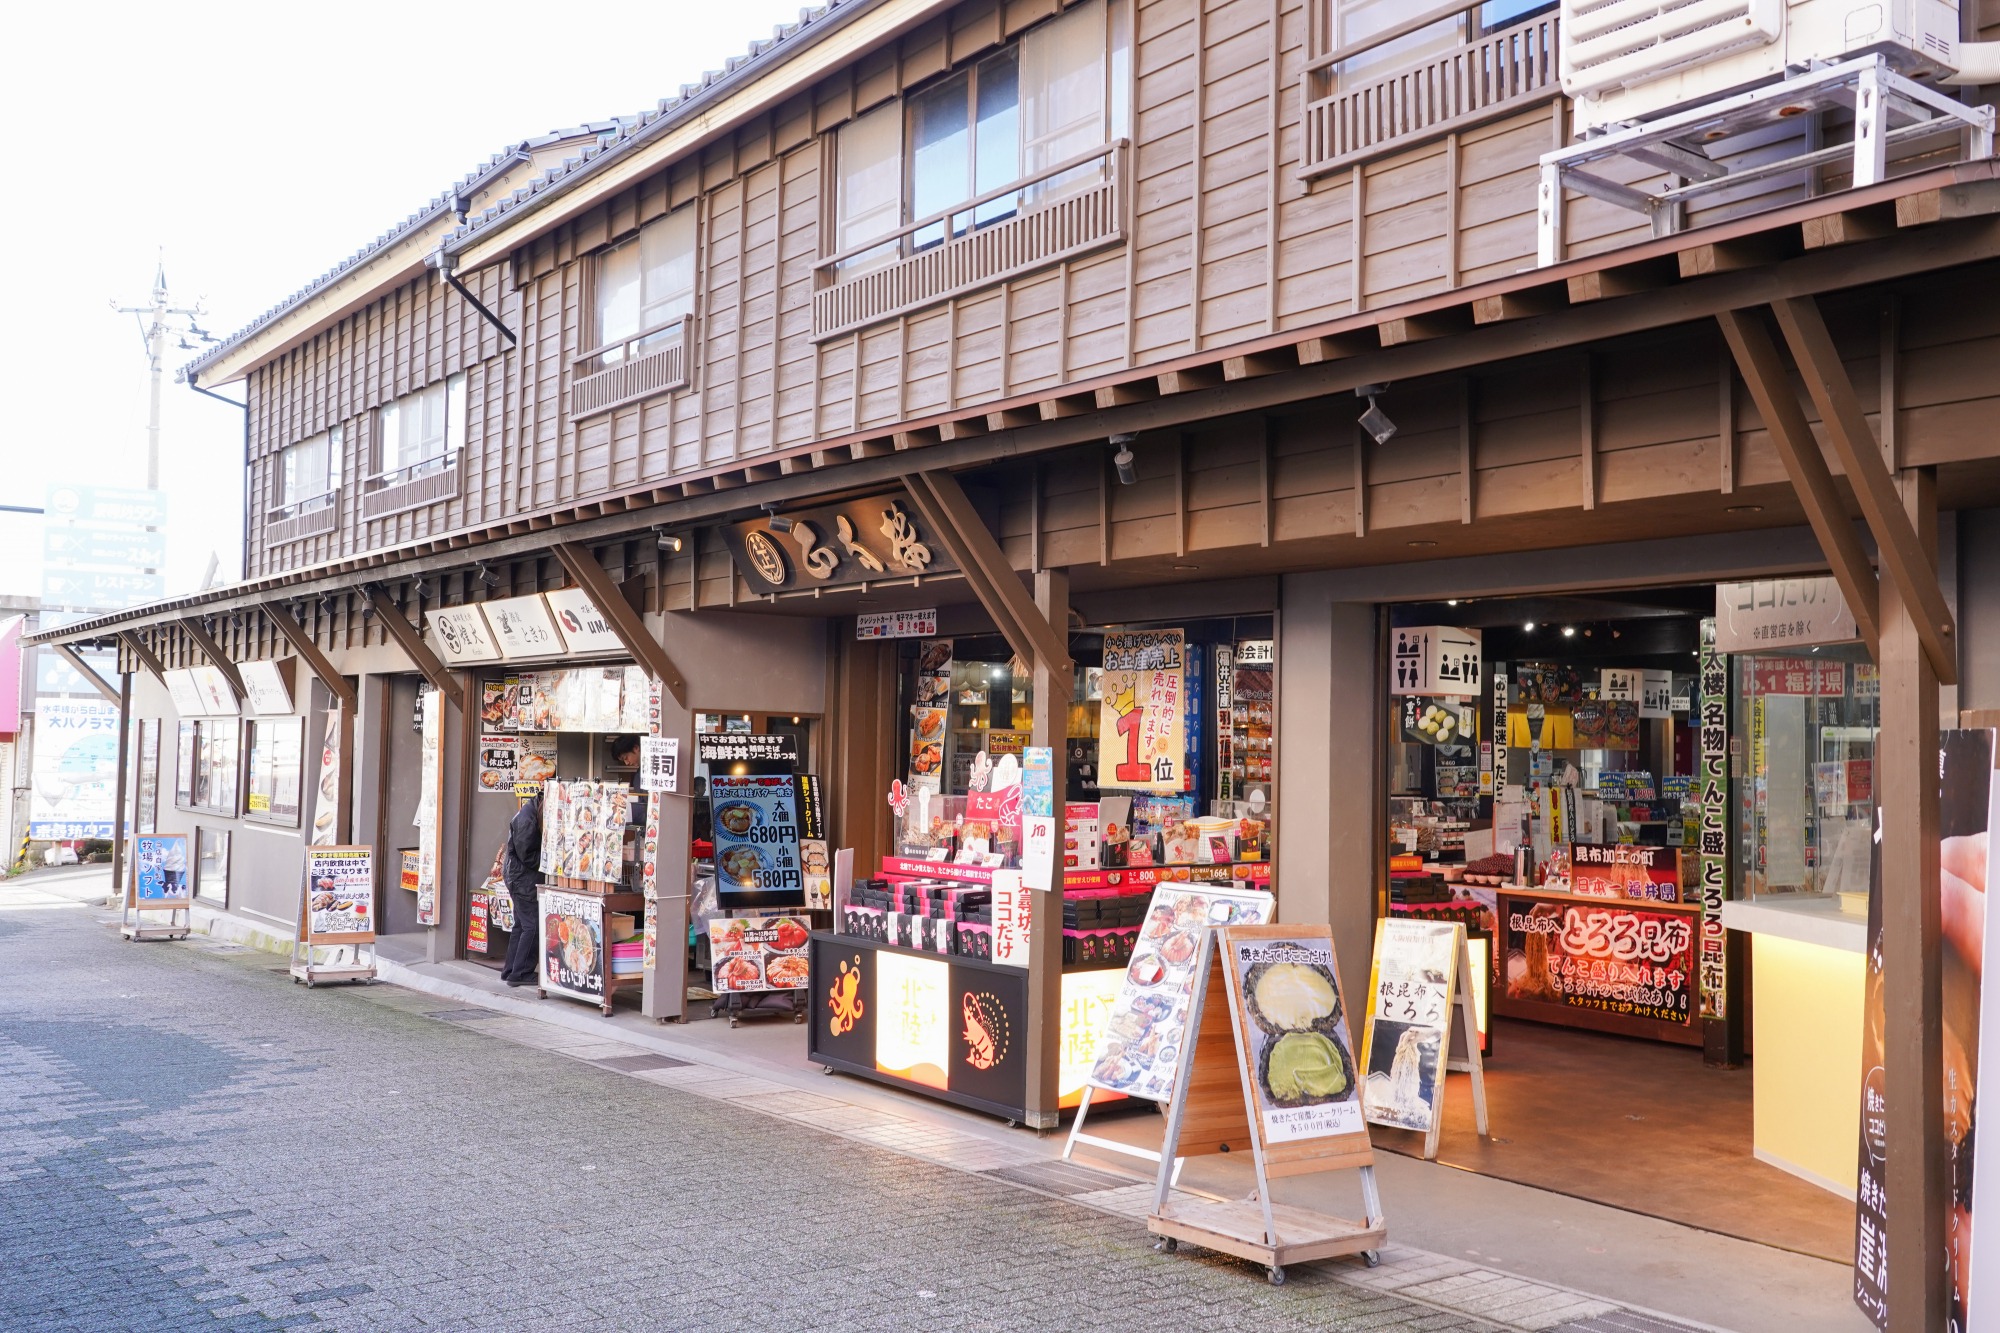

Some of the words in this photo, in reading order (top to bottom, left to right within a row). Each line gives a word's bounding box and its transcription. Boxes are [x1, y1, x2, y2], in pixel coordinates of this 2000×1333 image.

[860, 615, 894, 625] クレジットカード
[896, 611, 936, 621] 電子マネー使えます
[1753, 620, 1812, 640] ※直営店を除く
[1105, 633, 1181, 650] から揚げせんべい
[1104, 649, 1182, 672] お土産売上
[1217, 650, 1231, 709] 福井土産
[1785, 671, 1843, 693] 福井県
[43, 705, 120, 716] 水平線から白山ま
[1144, 670, 1166, 749] 売れてます
[1159, 674, 1179, 736] 圧倒的に
[700, 735, 785, 744] 中でお食事できます
[749, 745, 780, 753] 越前そば
[1115, 706, 1152, 782] 1
[489, 758, 512, 767] 休止中
[493, 750, 509, 758] 販売
[701, 745, 748, 760] 海鮮丼
[749, 752, 797, 760] ソースかつ丼
[650, 754, 676, 777] 寿司
[1153, 757, 1175, 782] 位
[516, 785, 540, 794] いか焼き
[1702, 701, 1726, 857] 名物てんこ盛
[713, 788, 793, 799] ほたて貝柱バター焼き
[771, 811, 789, 822] 2個
[774, 801, 785, 811] 大
[749, 826, 797, 843] 680円
[778, 845, 789, 856] 小
[1575, 846, 1654, 867] 昆布加工の町
[142, 841, 154, 897] 牧場ソフト
[311, 868, 371, 876] ご注文になります
[776, 856, 793, 868] 5個
[752, 869, 800, 888] 580円
[1577, 876, 1622, 895] 日本一
[1627, 880, 1676, 900] 福井県
[545, 893, 600, 922] 贅沢に2杯使用
[997, 891, 1014, 959] ココだけ
[1509, 914, 1562, 935] 根昆布入
[1561, 909, 1690, 962] とろろ昆布
[1240, 946, 1333, 965] 焼きたてはここだけ!
[560, 967, 602, 991] せいこがに丼
[1549, 955, 1685, 990] てんこ盛り入れます
[1380, 981, 1446, 1000] 根昆布入
[1552, 976, 1687, 1010] とろろ汁のご試飲あり！
[1383, 998, 1440, 1023] とろろ
[1568, 996, 1688, 1022] スタッフまでお声かけください
[1067, 997, 1097, 1065] 北陸
[1948, 1068, 1961, 1303] 生カスタードクリーム
